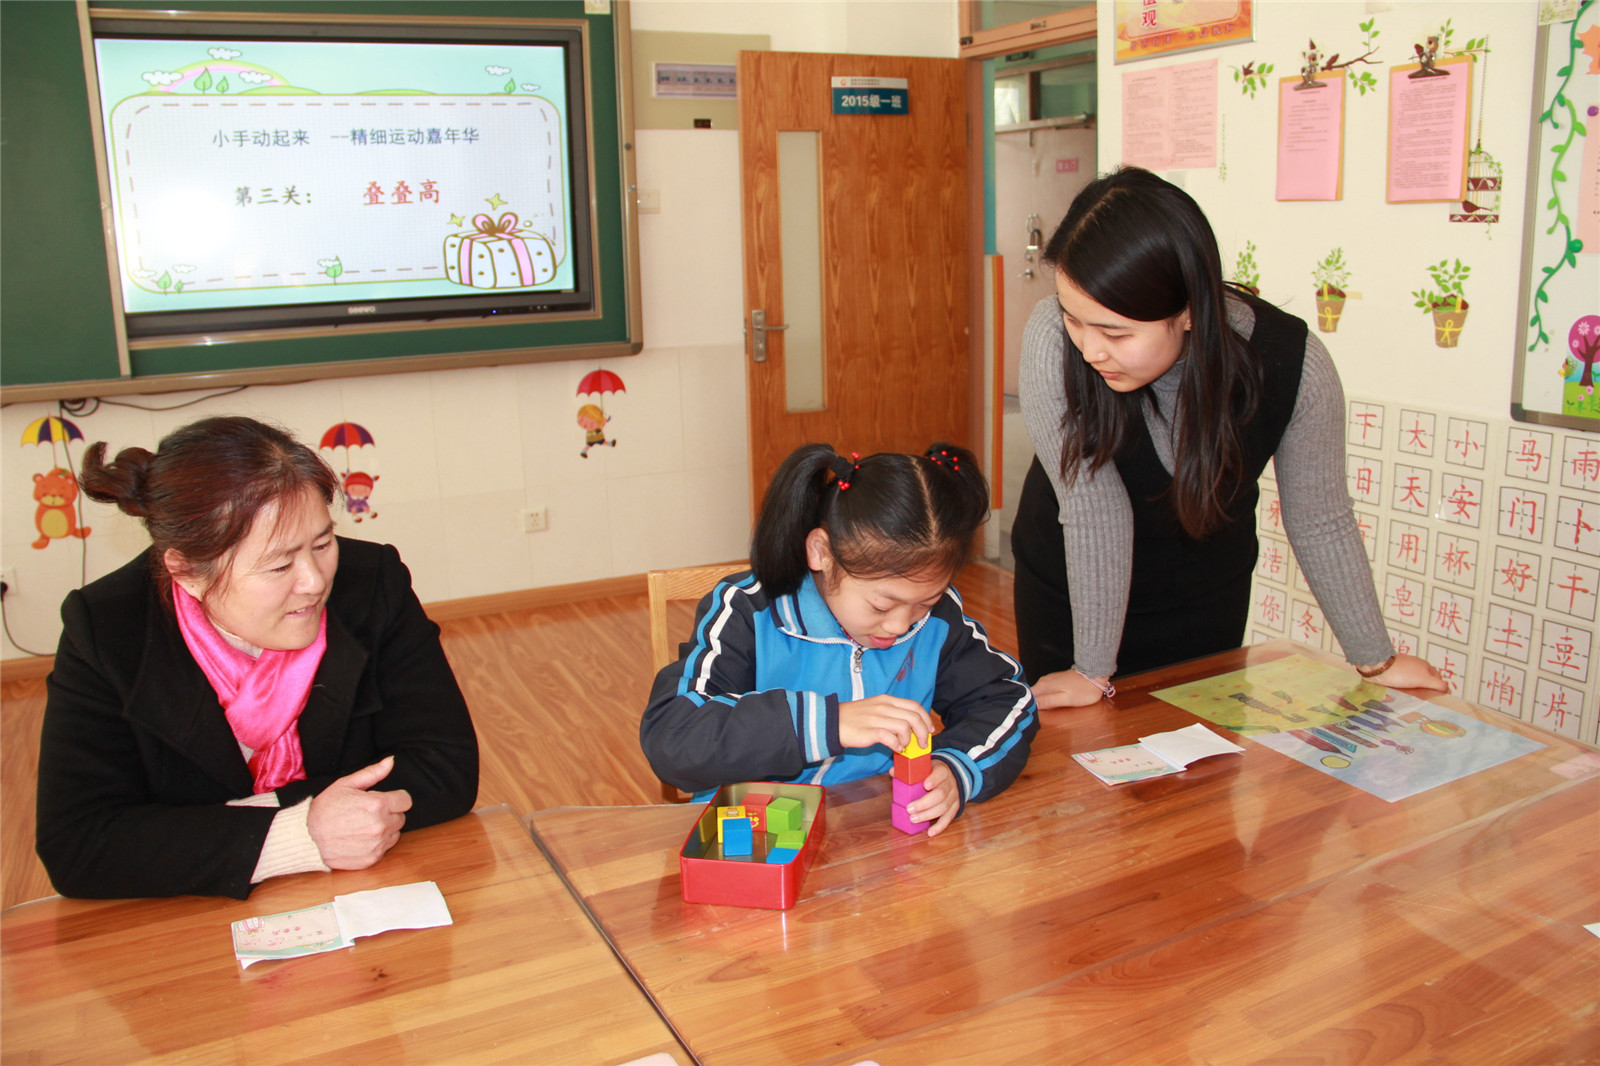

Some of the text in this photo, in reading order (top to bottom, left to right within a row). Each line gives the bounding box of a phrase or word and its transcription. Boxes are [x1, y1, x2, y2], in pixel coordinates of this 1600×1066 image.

[841, 94, 902, 108] 2015级一班
[212, 128, 311, 148] 小手动起来
[363, 178, 440, 206] 叠叠高
[1356, 414, 1478, 457] 下 大 小
[1517, 440, 1600, 481] 马 雨
[1357, 468, 1477, 519] 日 天 安
[1509, 497, 1592, 544] 门 卜
[1263, 548, 1282, 573] 洁
[1398, 534, 1470, 574] 用 杯
[1501, 559, 1533, 592] 好
[1260, 594, 1280, 622] 你
[1298, 609, 1319, 639] 冬
[1392, 585, 1461, 634] 皂 肤
[1494, 618, 1580, 670] 土 豆
[1487, 672, 1567, 728] 怕 片
